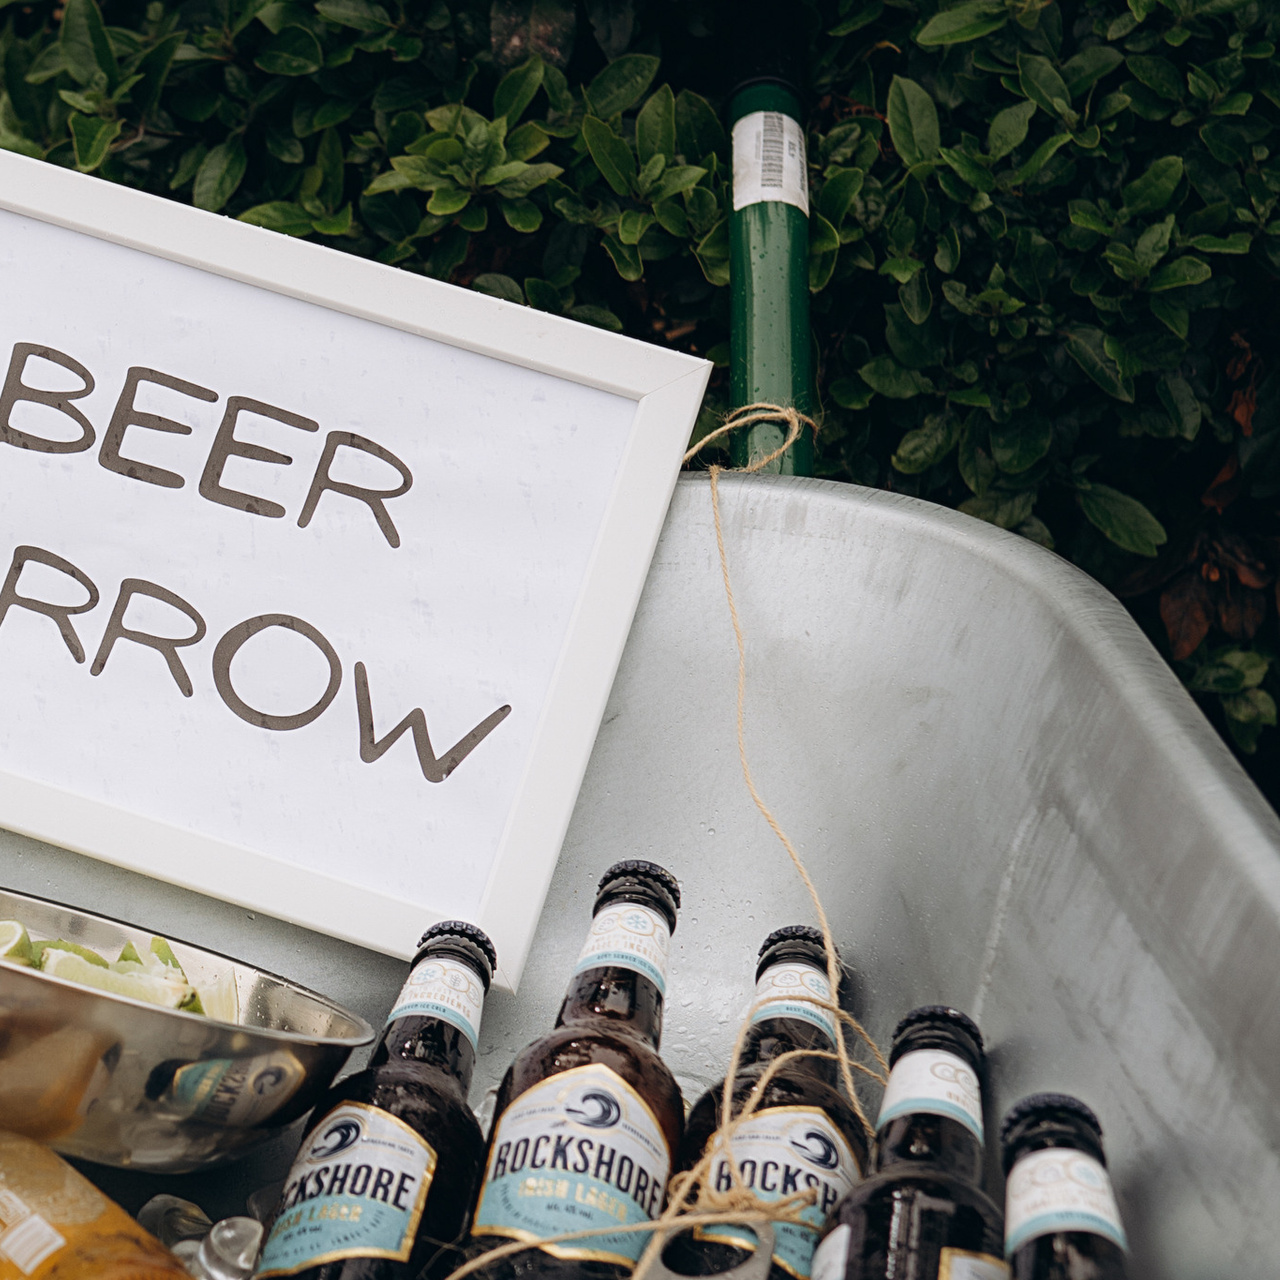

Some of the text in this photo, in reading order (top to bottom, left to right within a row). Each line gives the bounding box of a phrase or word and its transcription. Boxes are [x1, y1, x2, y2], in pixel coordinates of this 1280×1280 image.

[275, 1163, 416, 1218] CKSHORE
[493, 1134, 662, 1221] ROCKSHORE
[715, 1159, 838, 1217] ROCKSH
